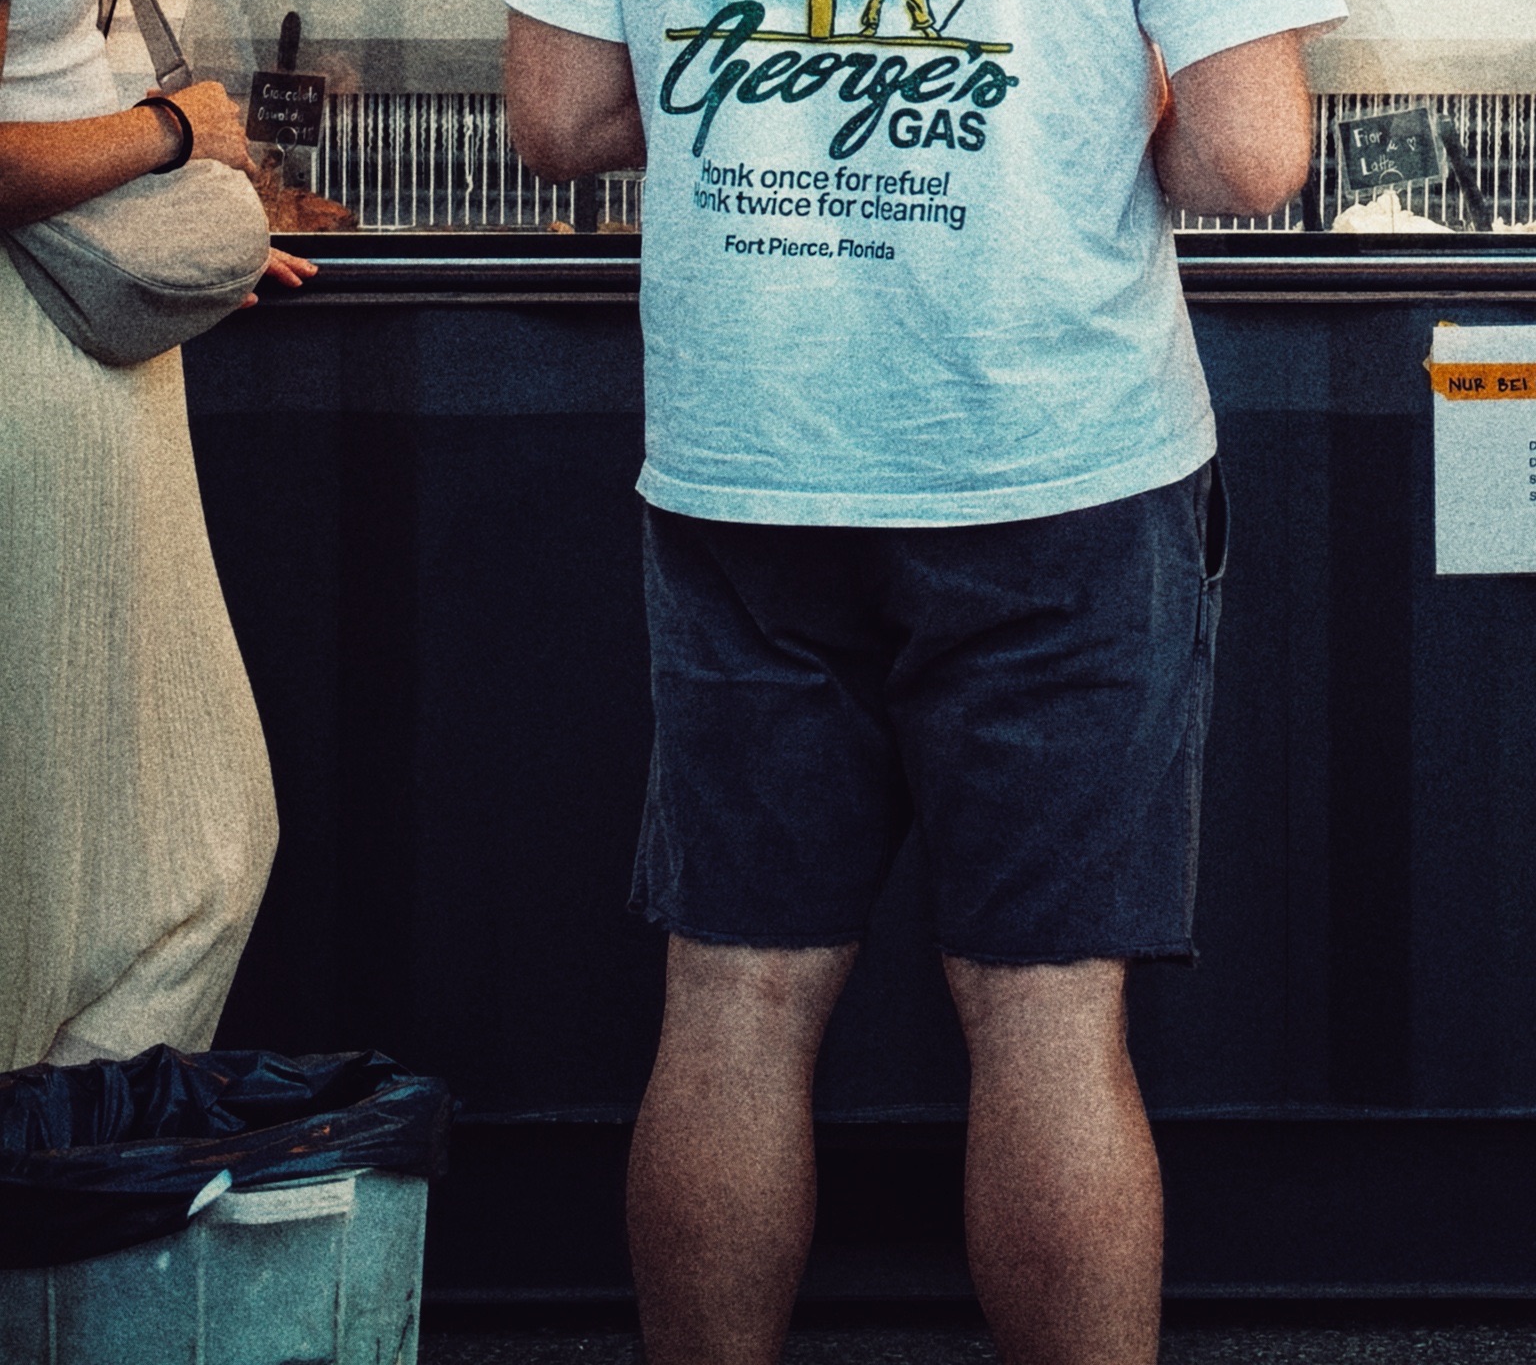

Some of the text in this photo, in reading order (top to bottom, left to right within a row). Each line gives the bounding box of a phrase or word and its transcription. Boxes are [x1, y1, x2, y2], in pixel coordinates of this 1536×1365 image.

[659, 0, 1020, 160] George's
[888, 107, 988, 152] GAS
[1353, 128, 1383, 148] Fior
[700, 157, 951, 197] Honk once for refuel
[1360, 154, 1399, 177] Latte
[736, 190, 811, 218] twice
[817, 190, 857, 219] for
[860, 195, 967, 231] cleaning
[724, 235, 896, 261] Fort Pierce, Florida
[1448, 376, 1486, 393] NUR
[1497, 377, 1527, 392] BEI
